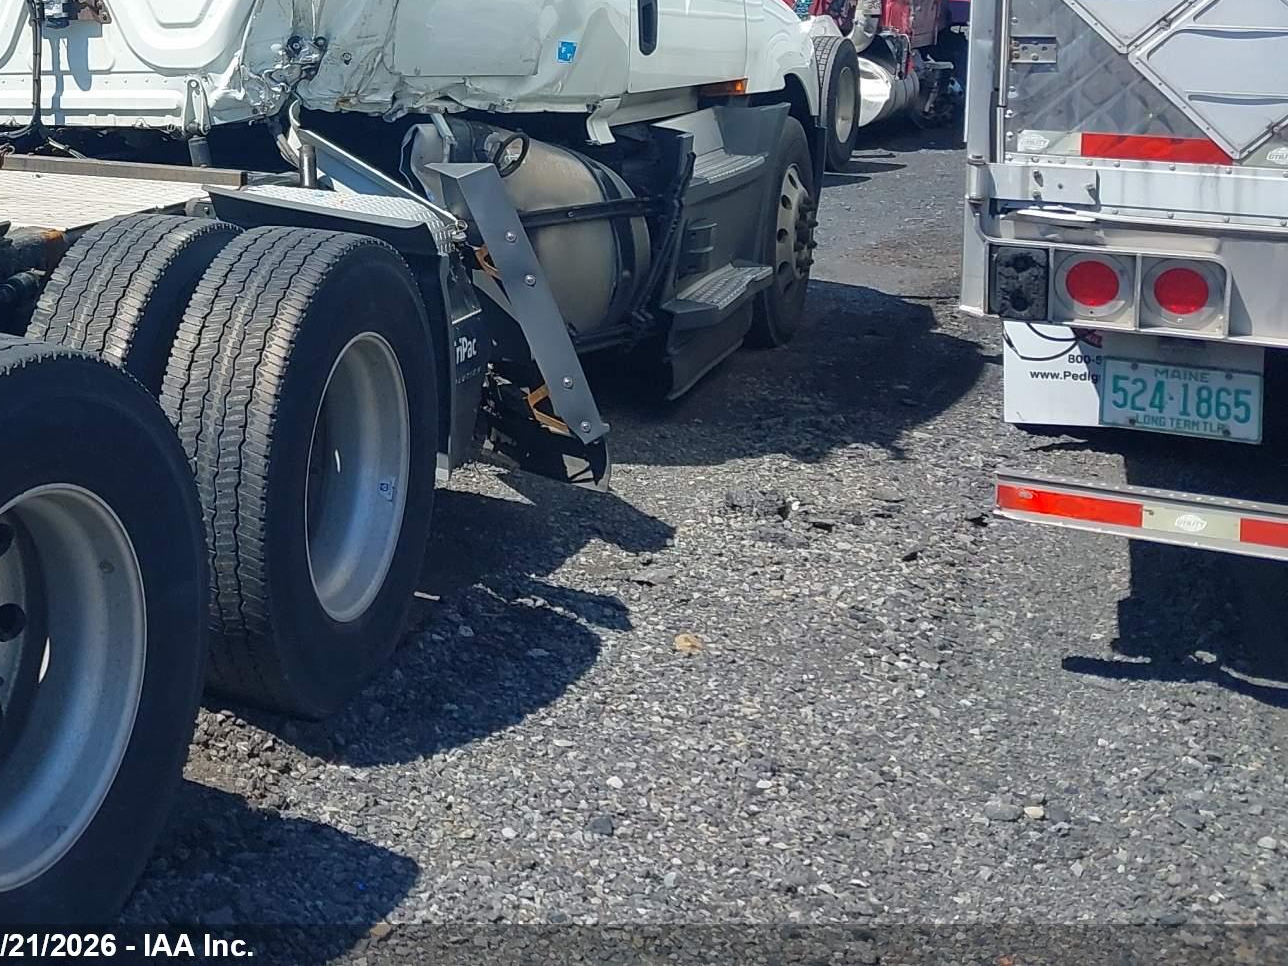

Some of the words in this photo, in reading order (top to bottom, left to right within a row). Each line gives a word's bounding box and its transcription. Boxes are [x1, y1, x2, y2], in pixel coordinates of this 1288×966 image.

[1154, 368, 1210, 383] MAINE
[1135, 414, 1165, 427] LONG
[1169, 417, 1200, 431] TERM
